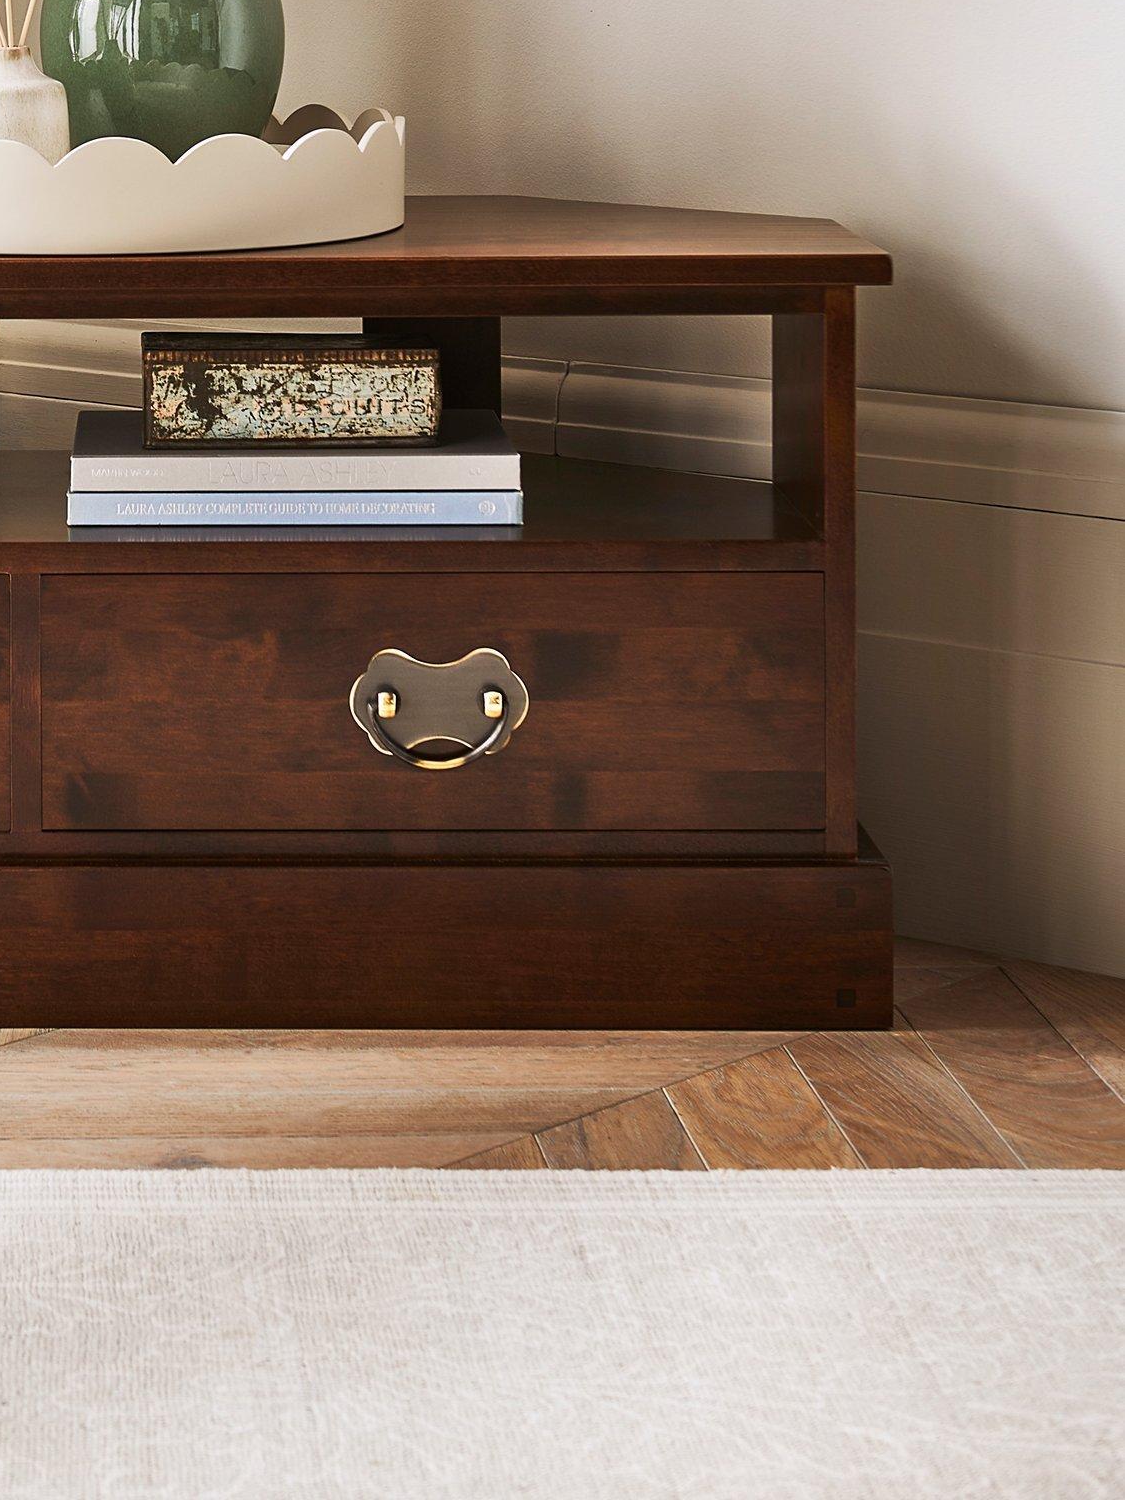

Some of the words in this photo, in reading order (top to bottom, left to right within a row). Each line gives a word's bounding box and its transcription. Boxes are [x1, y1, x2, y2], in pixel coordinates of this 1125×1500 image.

[209, 460, 291, 485] LAURA
[300, 460, 397, 486] ASHLEY
[116, 503, 156, 516] LAURA
[158, 503, 202, 516] ASHLEY
[205, 503, 268, 516] COMPLETE
[269, 503, 305, 516] GUIDE
[308, 503, 324, 515] TO
[326, 503, 359, 515] HOME
[362, 503, 436, 515] DECORATING
